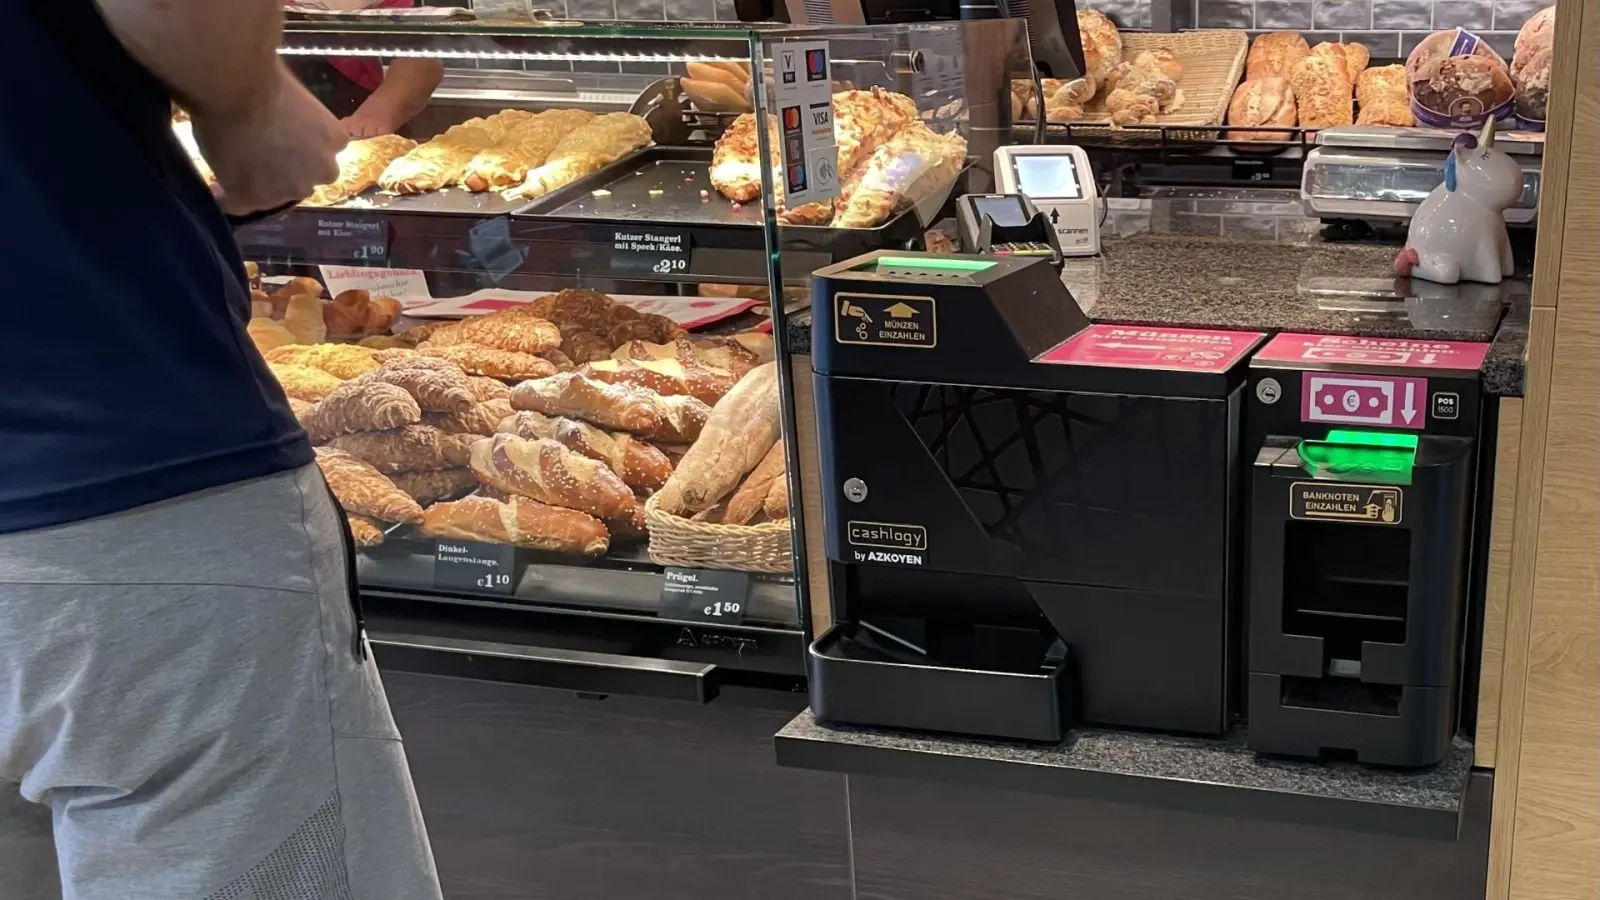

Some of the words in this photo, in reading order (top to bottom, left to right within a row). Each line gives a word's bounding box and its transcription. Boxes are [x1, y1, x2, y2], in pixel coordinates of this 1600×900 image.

[812, 111, 829, 126] VISA
[614, 232, 643, 241] Kutzer
[644, 233, 681, 244] Stangerl
[614, 242, 629, 250] mit
[884, 320, 920, 330] MÜNZEN
[879, 330, 926, 341] EINZAHLEN
[1320, 337, 1451, 349] Scheine
[1438, 397, 1454, 405] POS
[1438, 406, 1453, 414] 1500
[1302, 491, 1360, 502] BANKNOTEN
[1305, 502, 1357, 512] EINZAHLEN
[852, 527, 922, 547] cashlogy
[438, 544, 469, 554] Dinkel-
[438, 553, 500, 567] Laugenstange.
[854, 550, 866, 562] by
[868, 551, 922, 565] AZKOYEN
[666, 571, 699, 583] Prügel.
